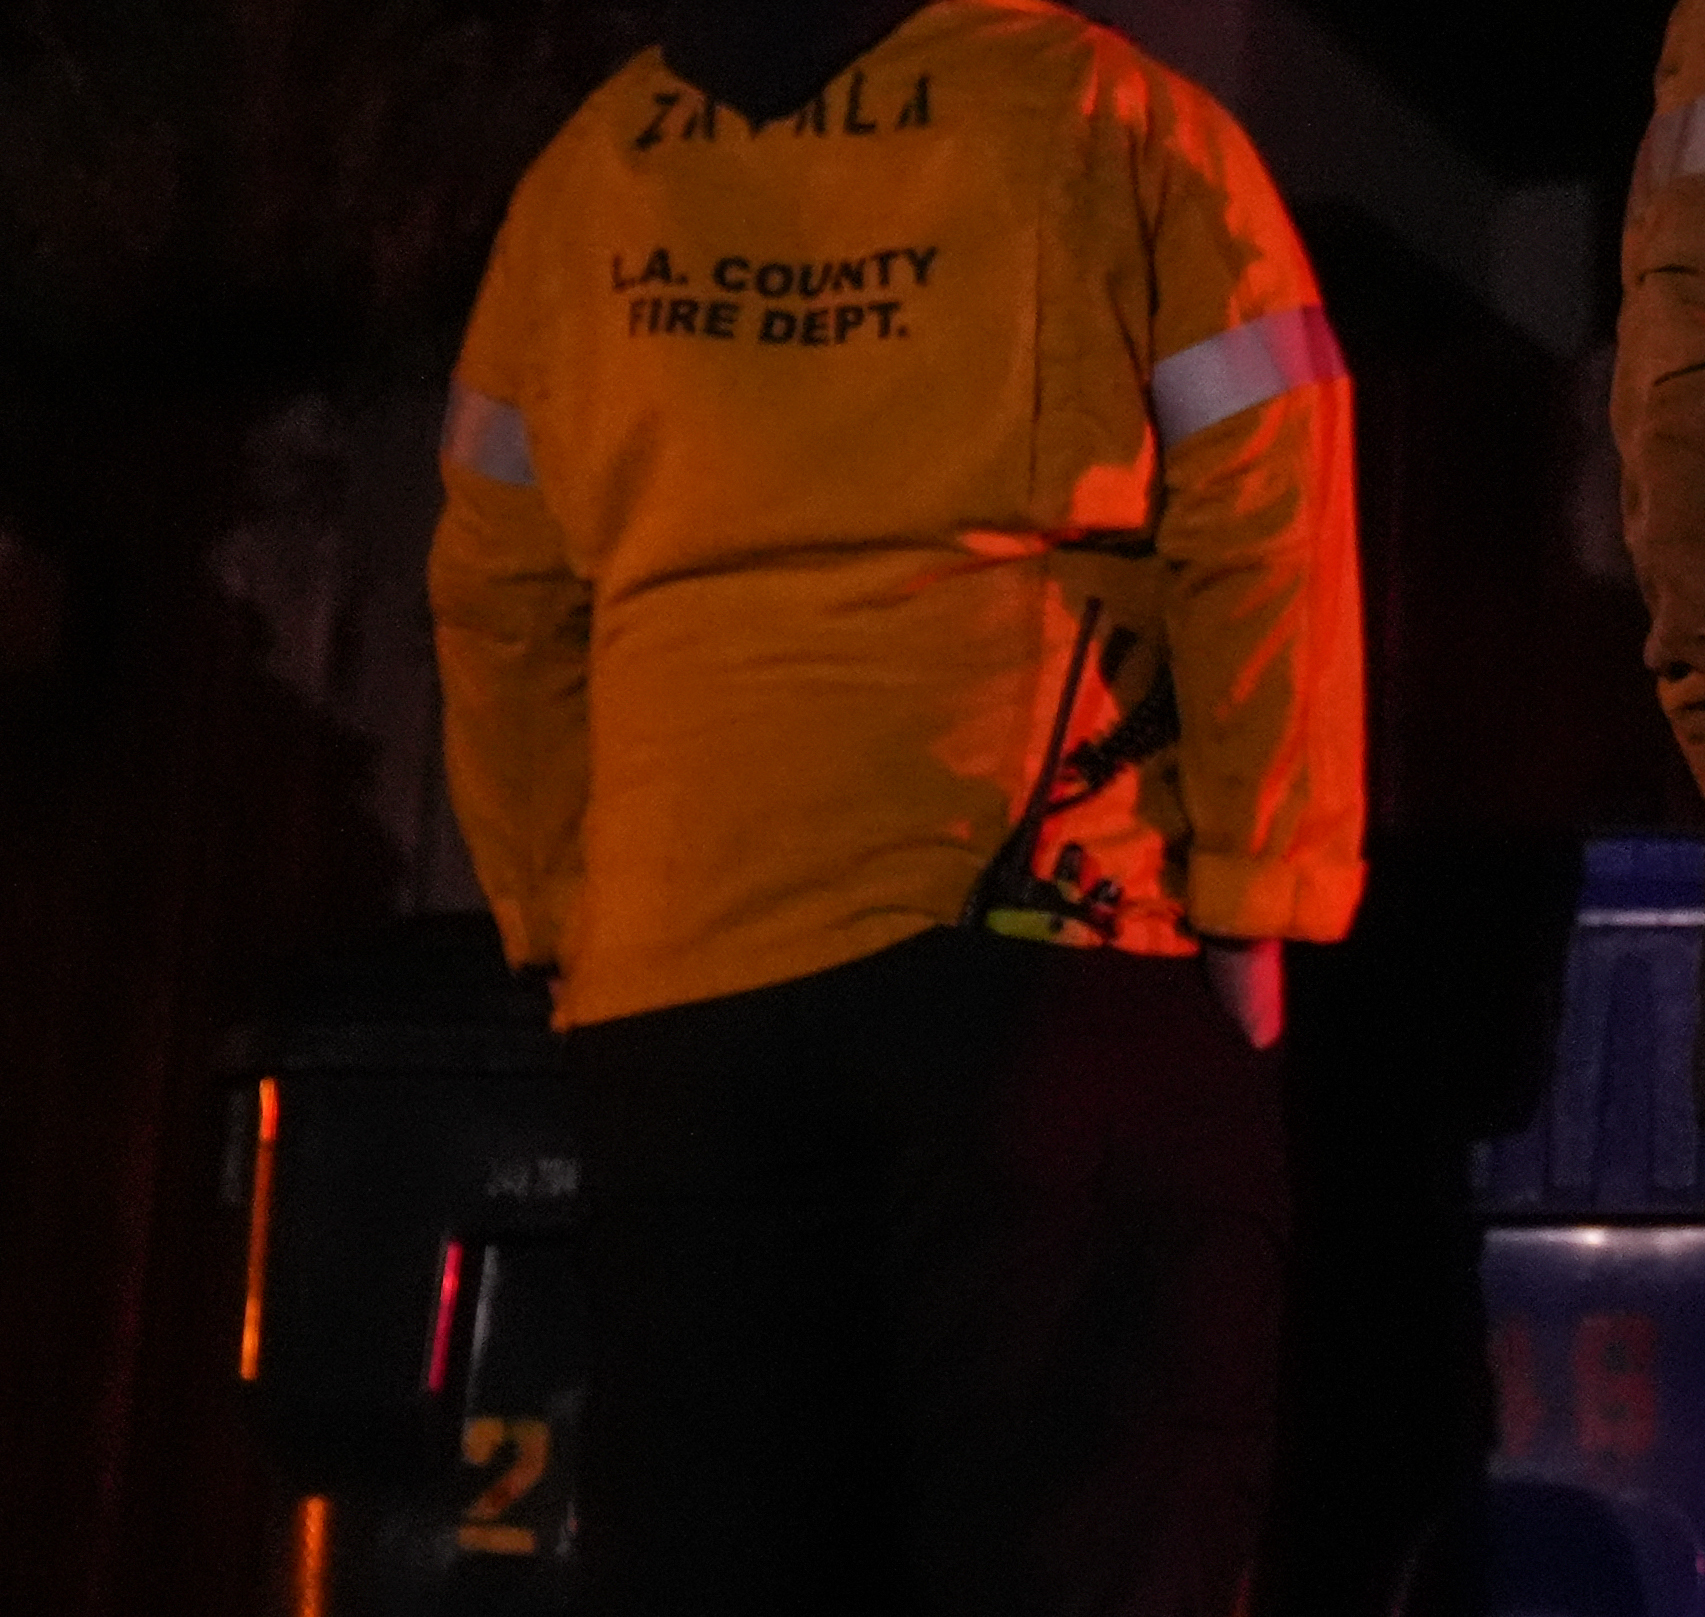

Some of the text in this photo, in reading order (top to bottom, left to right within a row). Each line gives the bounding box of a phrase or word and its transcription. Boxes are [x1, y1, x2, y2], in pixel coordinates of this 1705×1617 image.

[631, 69, 929, 150] ZAALA
[612, 247, 937, 297] L.A. COUNTY
[629, 298, 910, 345] FIRE DEPT.
[455, 1415, 551, 1555] 2
